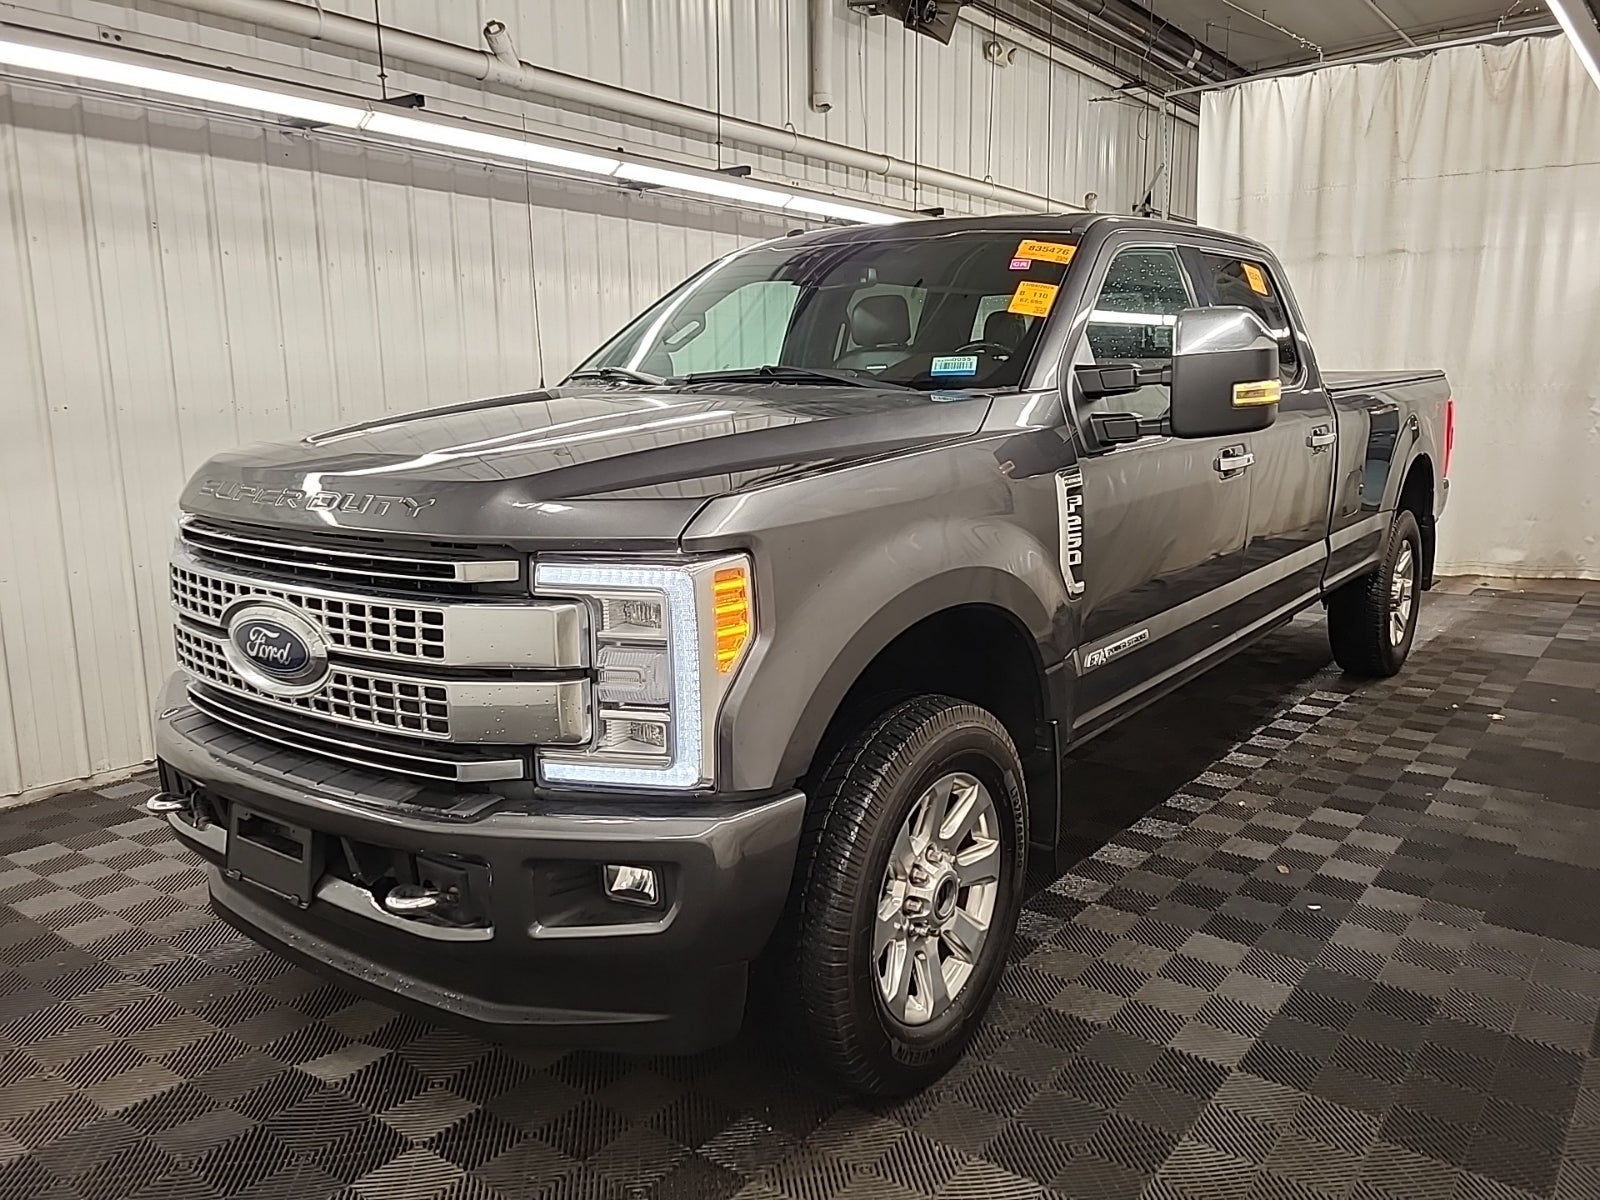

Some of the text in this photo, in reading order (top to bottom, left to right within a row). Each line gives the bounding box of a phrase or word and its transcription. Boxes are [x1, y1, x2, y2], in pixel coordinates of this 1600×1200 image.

[1028, 245, 1070, 255] 835476
[199, 479, 436, 518] SUPER DUTY
[246, 626, 292, 665] Ford
